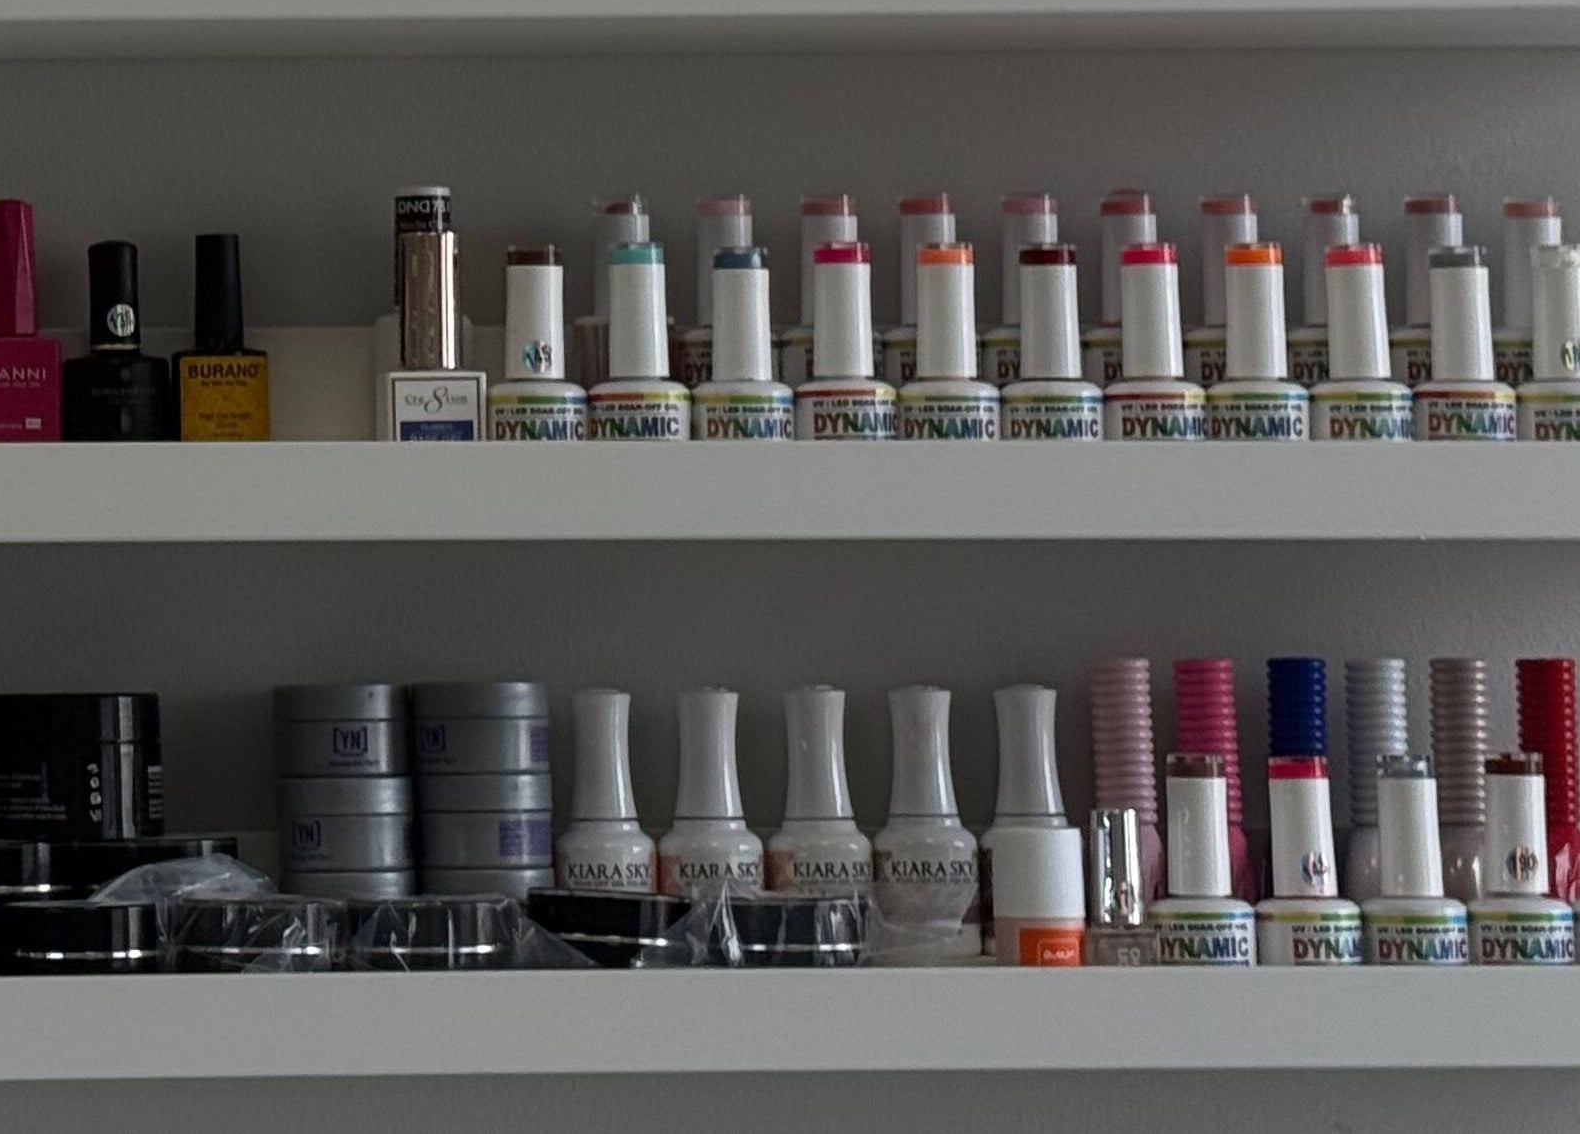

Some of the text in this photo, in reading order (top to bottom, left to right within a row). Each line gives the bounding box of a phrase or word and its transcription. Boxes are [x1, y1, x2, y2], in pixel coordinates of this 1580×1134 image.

[187, 364, 259, 379] BURANO
[495, 420, 584, 441] DYNAMIC
[589, 417, 680, 439] DYNAMIC
[707, 417, 792, 440] DYNAMIC
[904, 418, 995, 439] DYNAMIC
[1010, 418, 1099, 439] DYNAMIC
[1211, 417, 1304, 437] DYNAMIC
[1427, 412, 1515, 434] DYNAMIC
[567, 863, 651, 879] KIARA SKY
[678, 863, 733, 879] KIARA
[793, 862, 848, 878] KIARA
[890, 861, 973, 877] KIARA SKY
[1378, 938, 1467, 960] DYNAMIC
[1481, 937, 1573, 959] DYNAMIC
